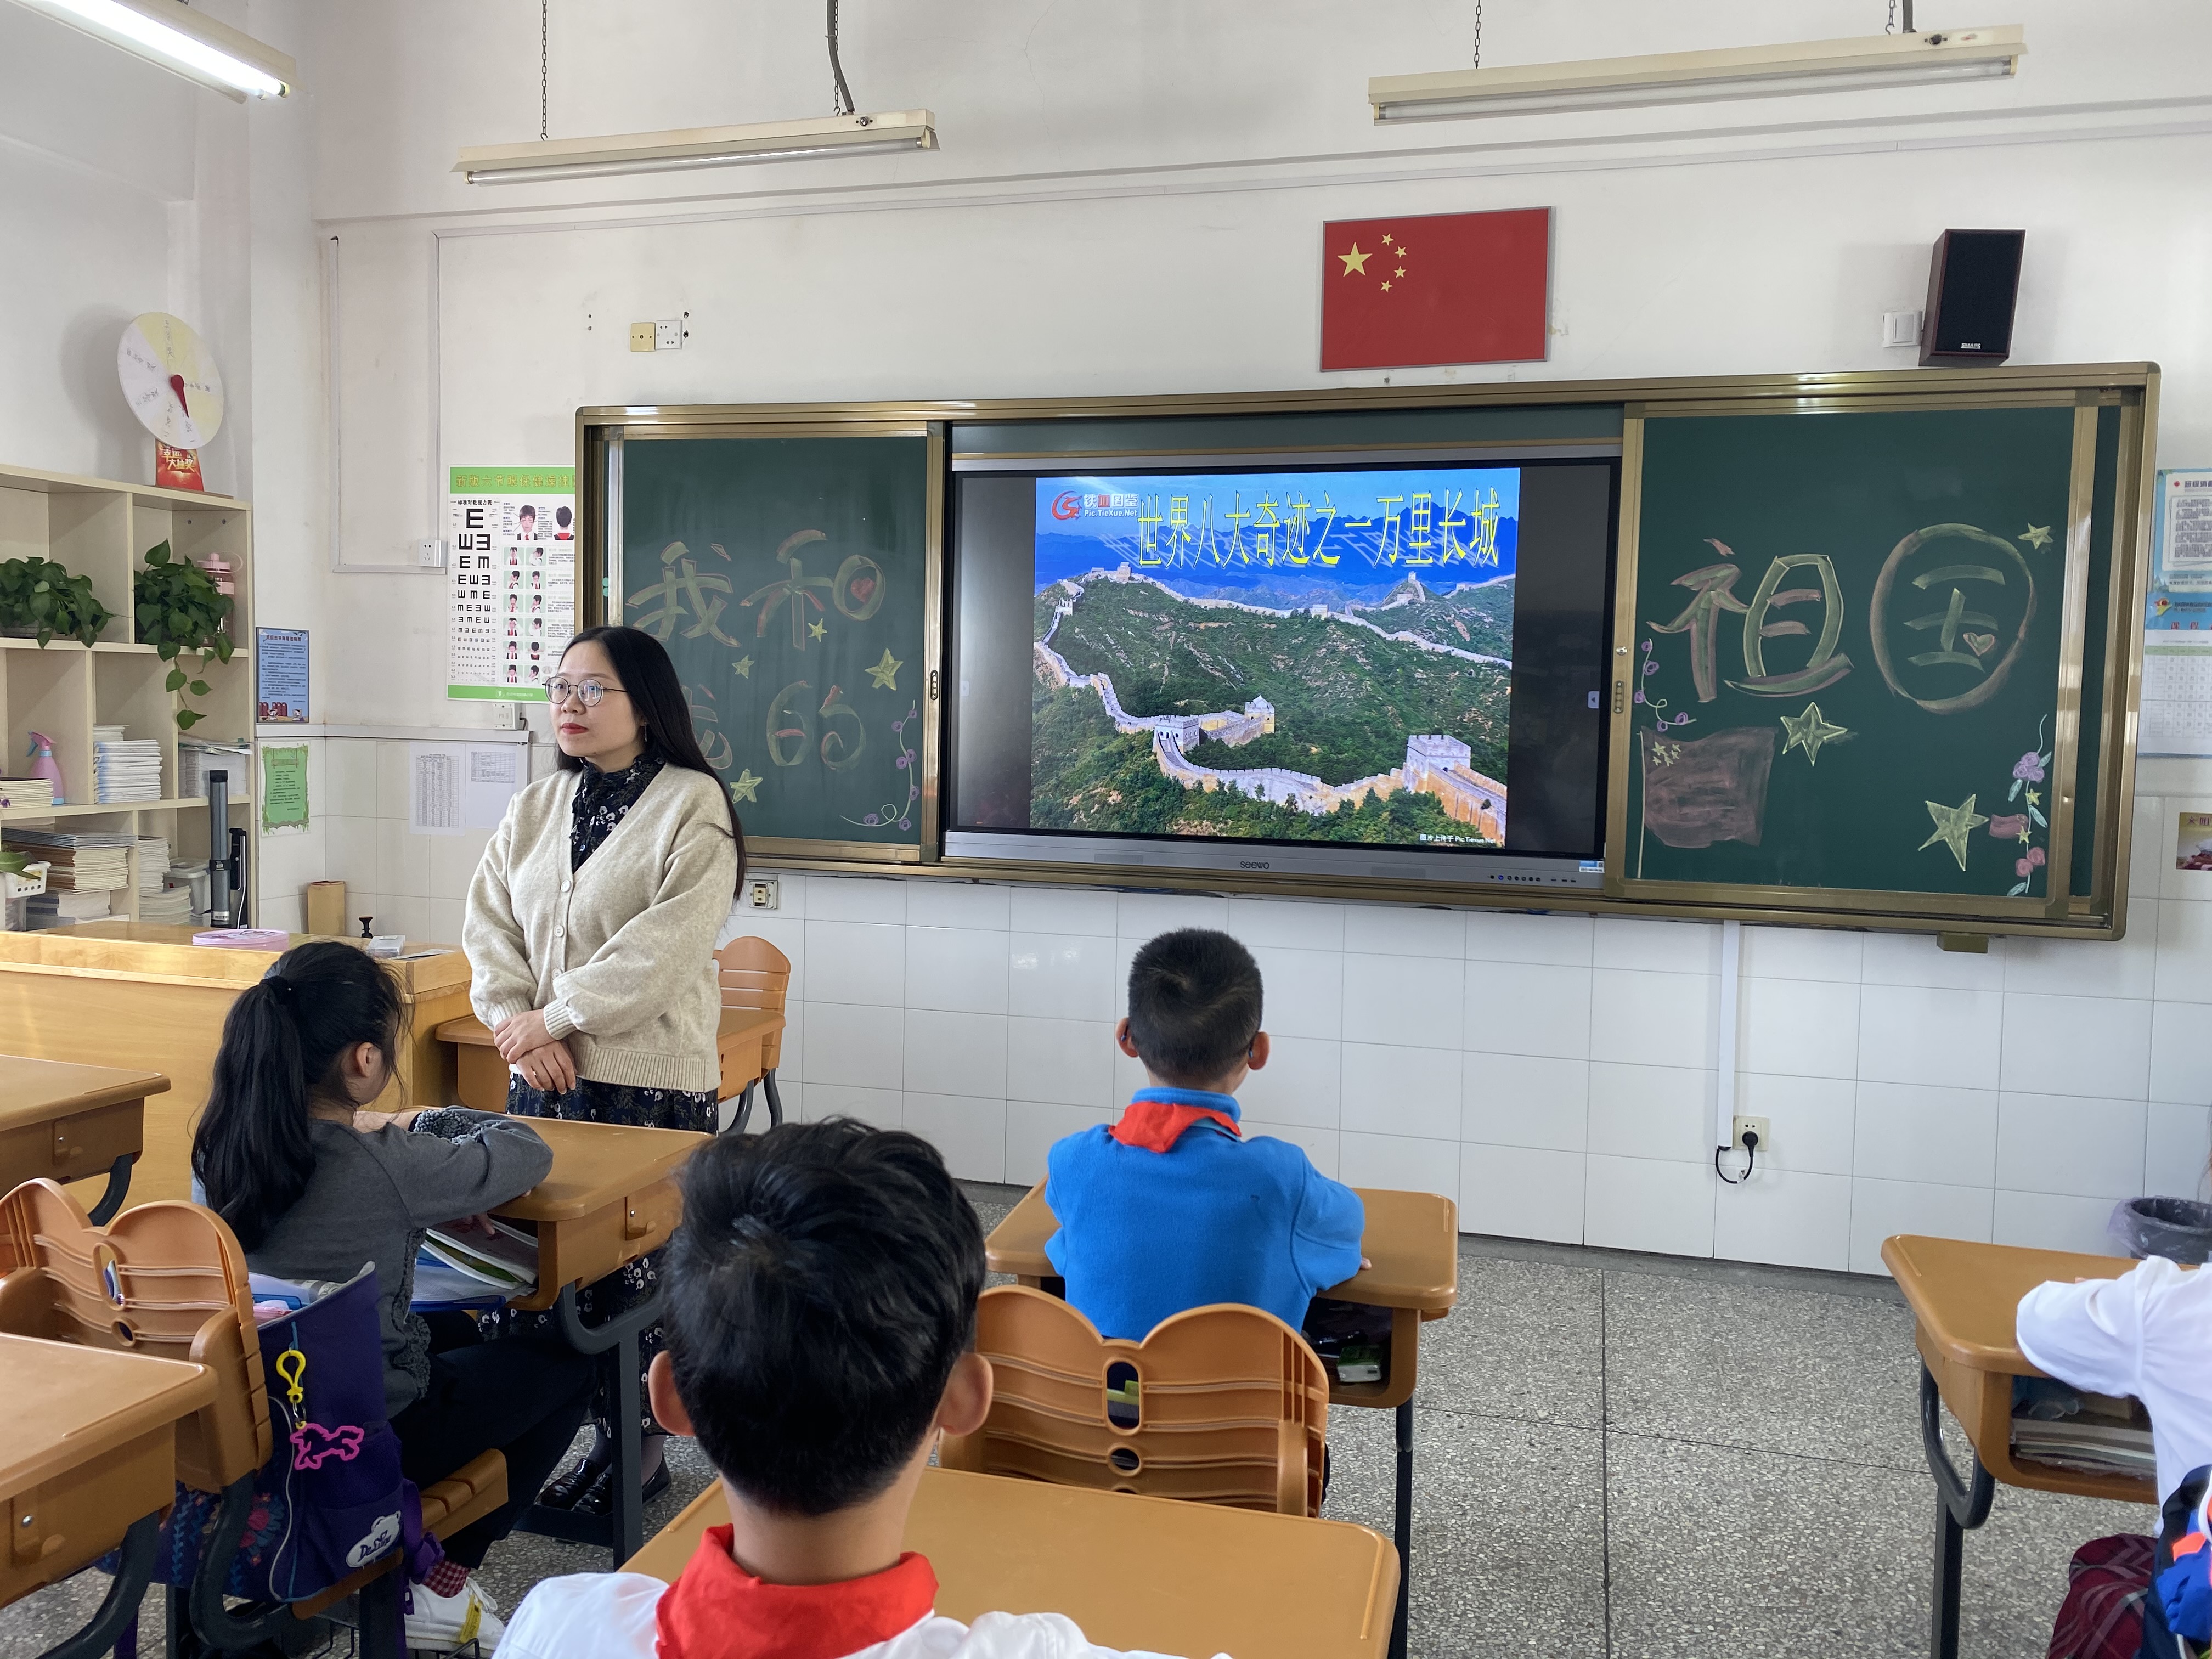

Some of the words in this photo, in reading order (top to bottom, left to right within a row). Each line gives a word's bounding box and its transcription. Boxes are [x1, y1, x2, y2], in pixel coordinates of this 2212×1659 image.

[167, 458, 195, 472] 大抽奖
[456, 473, 575, 488] 新版六节眼保健操挂
[1084, 493, 1139, 508] 铁血图鉴
[1084, 509, 1138, 518] Pic.TieXue.Net
[1137, 486, 1502, 569] 世界八大奇迹之一万里长城
[1646, 522, 2038, 715] 祖国
[1240, 860, 1270, 870] seewo
